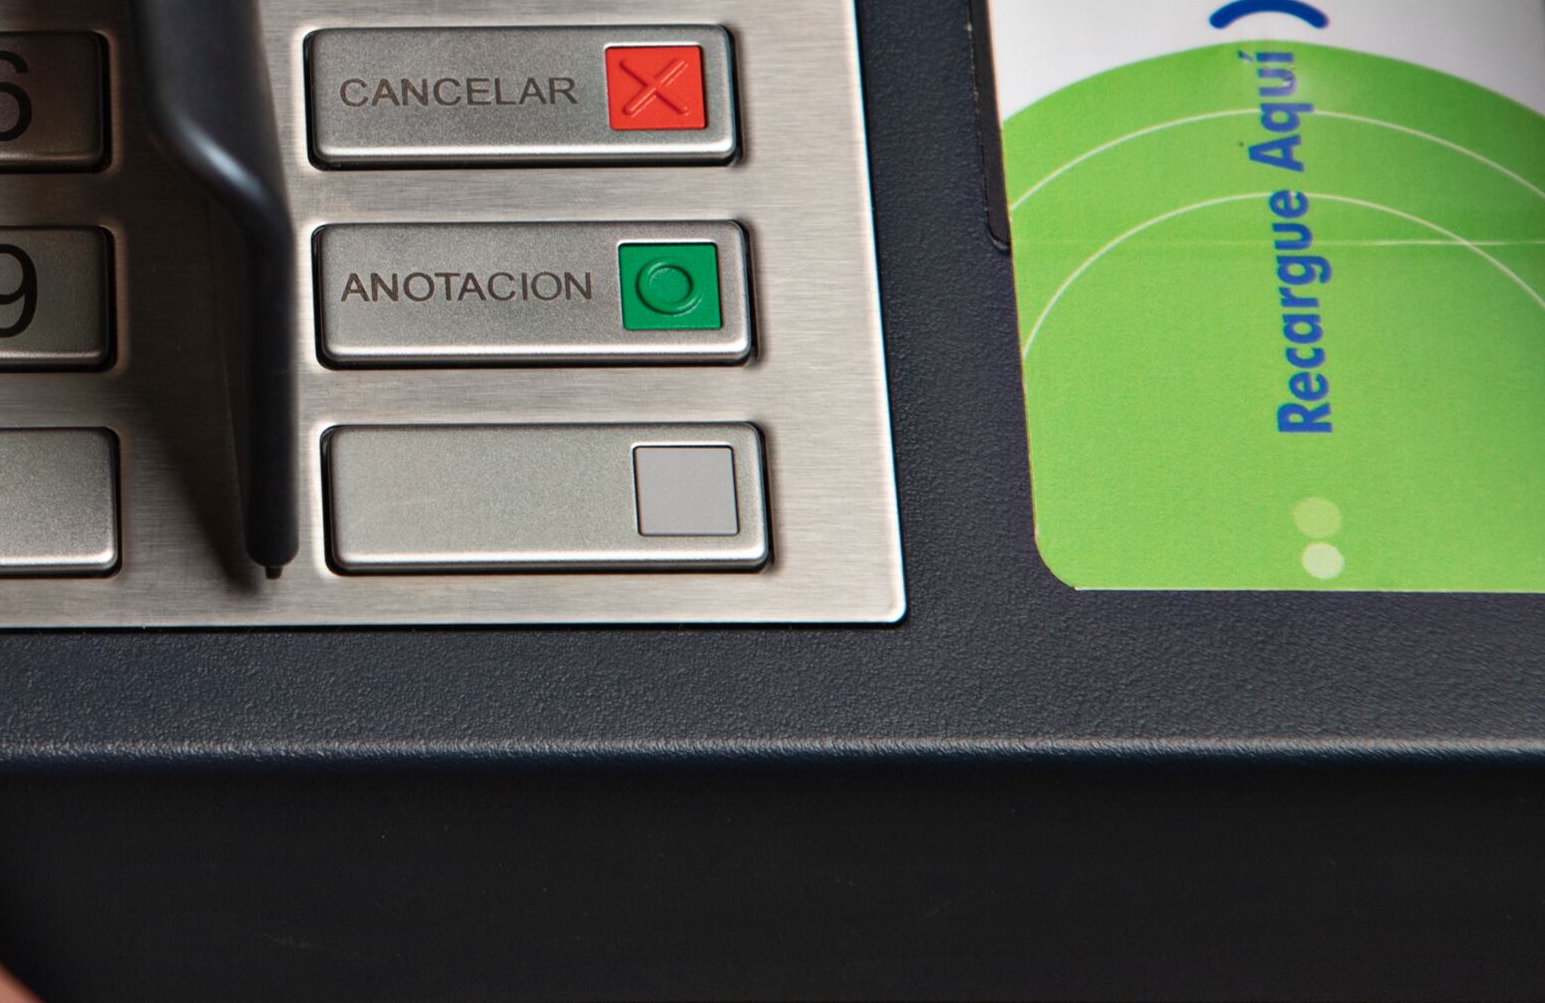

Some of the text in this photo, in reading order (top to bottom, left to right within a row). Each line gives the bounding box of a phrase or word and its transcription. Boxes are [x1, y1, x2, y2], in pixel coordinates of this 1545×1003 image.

[339, 77, 579, 107] CANCELAR
[1237, 50, 1332, 433] Recargue Aquí
[340, 270, 593, 302] ANOTACION
